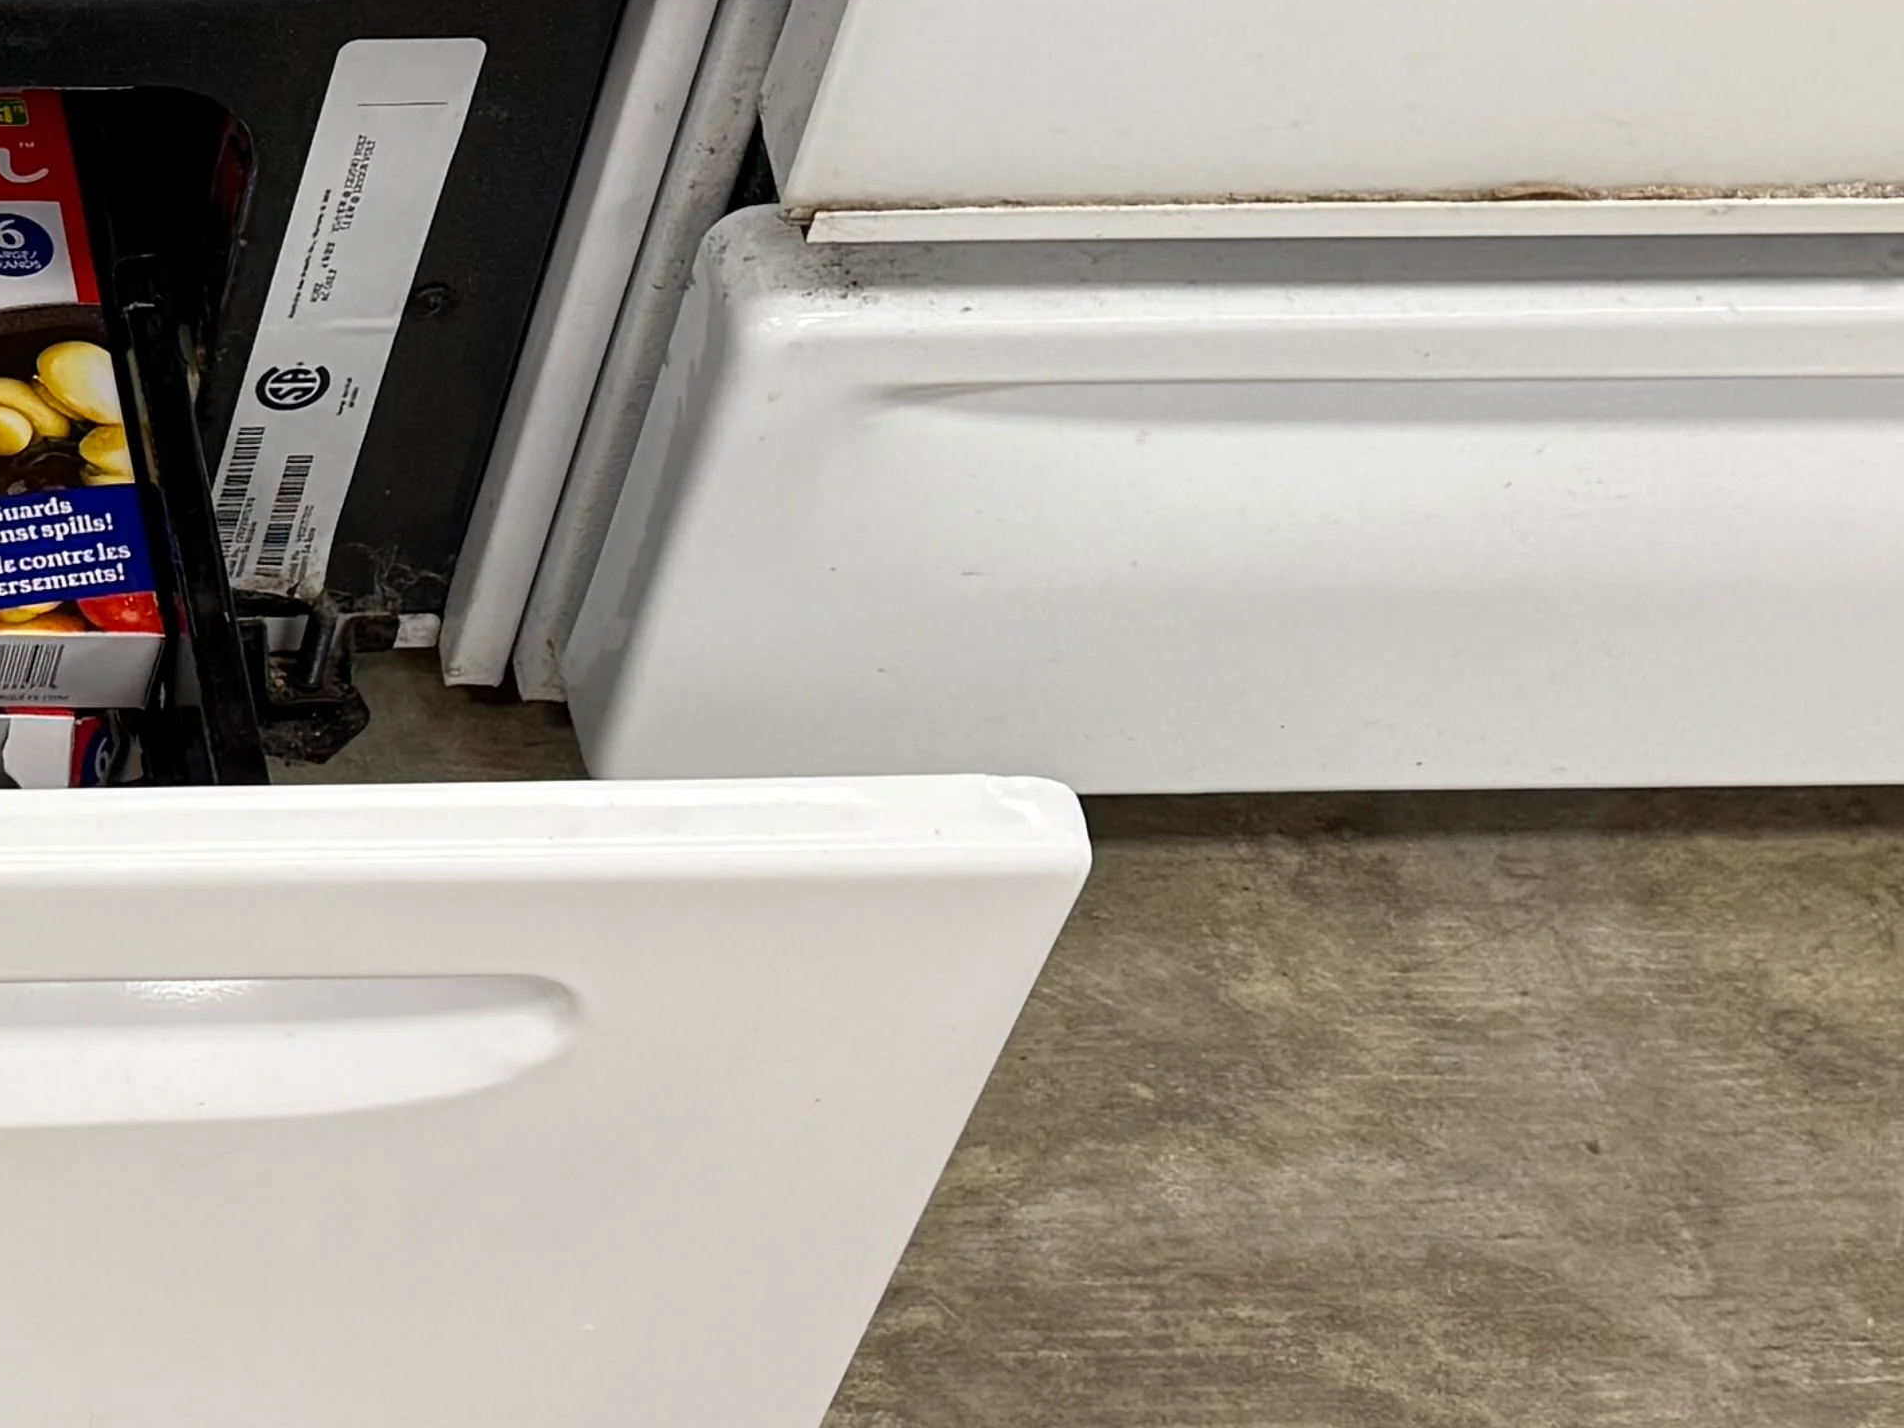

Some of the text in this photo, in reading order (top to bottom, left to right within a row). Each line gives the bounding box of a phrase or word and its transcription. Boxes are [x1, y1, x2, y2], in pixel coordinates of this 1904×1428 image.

[41, 512, 114, 542] spills!
[19, 548, 95, 571] contre
[98, 542, 132, 562] les
